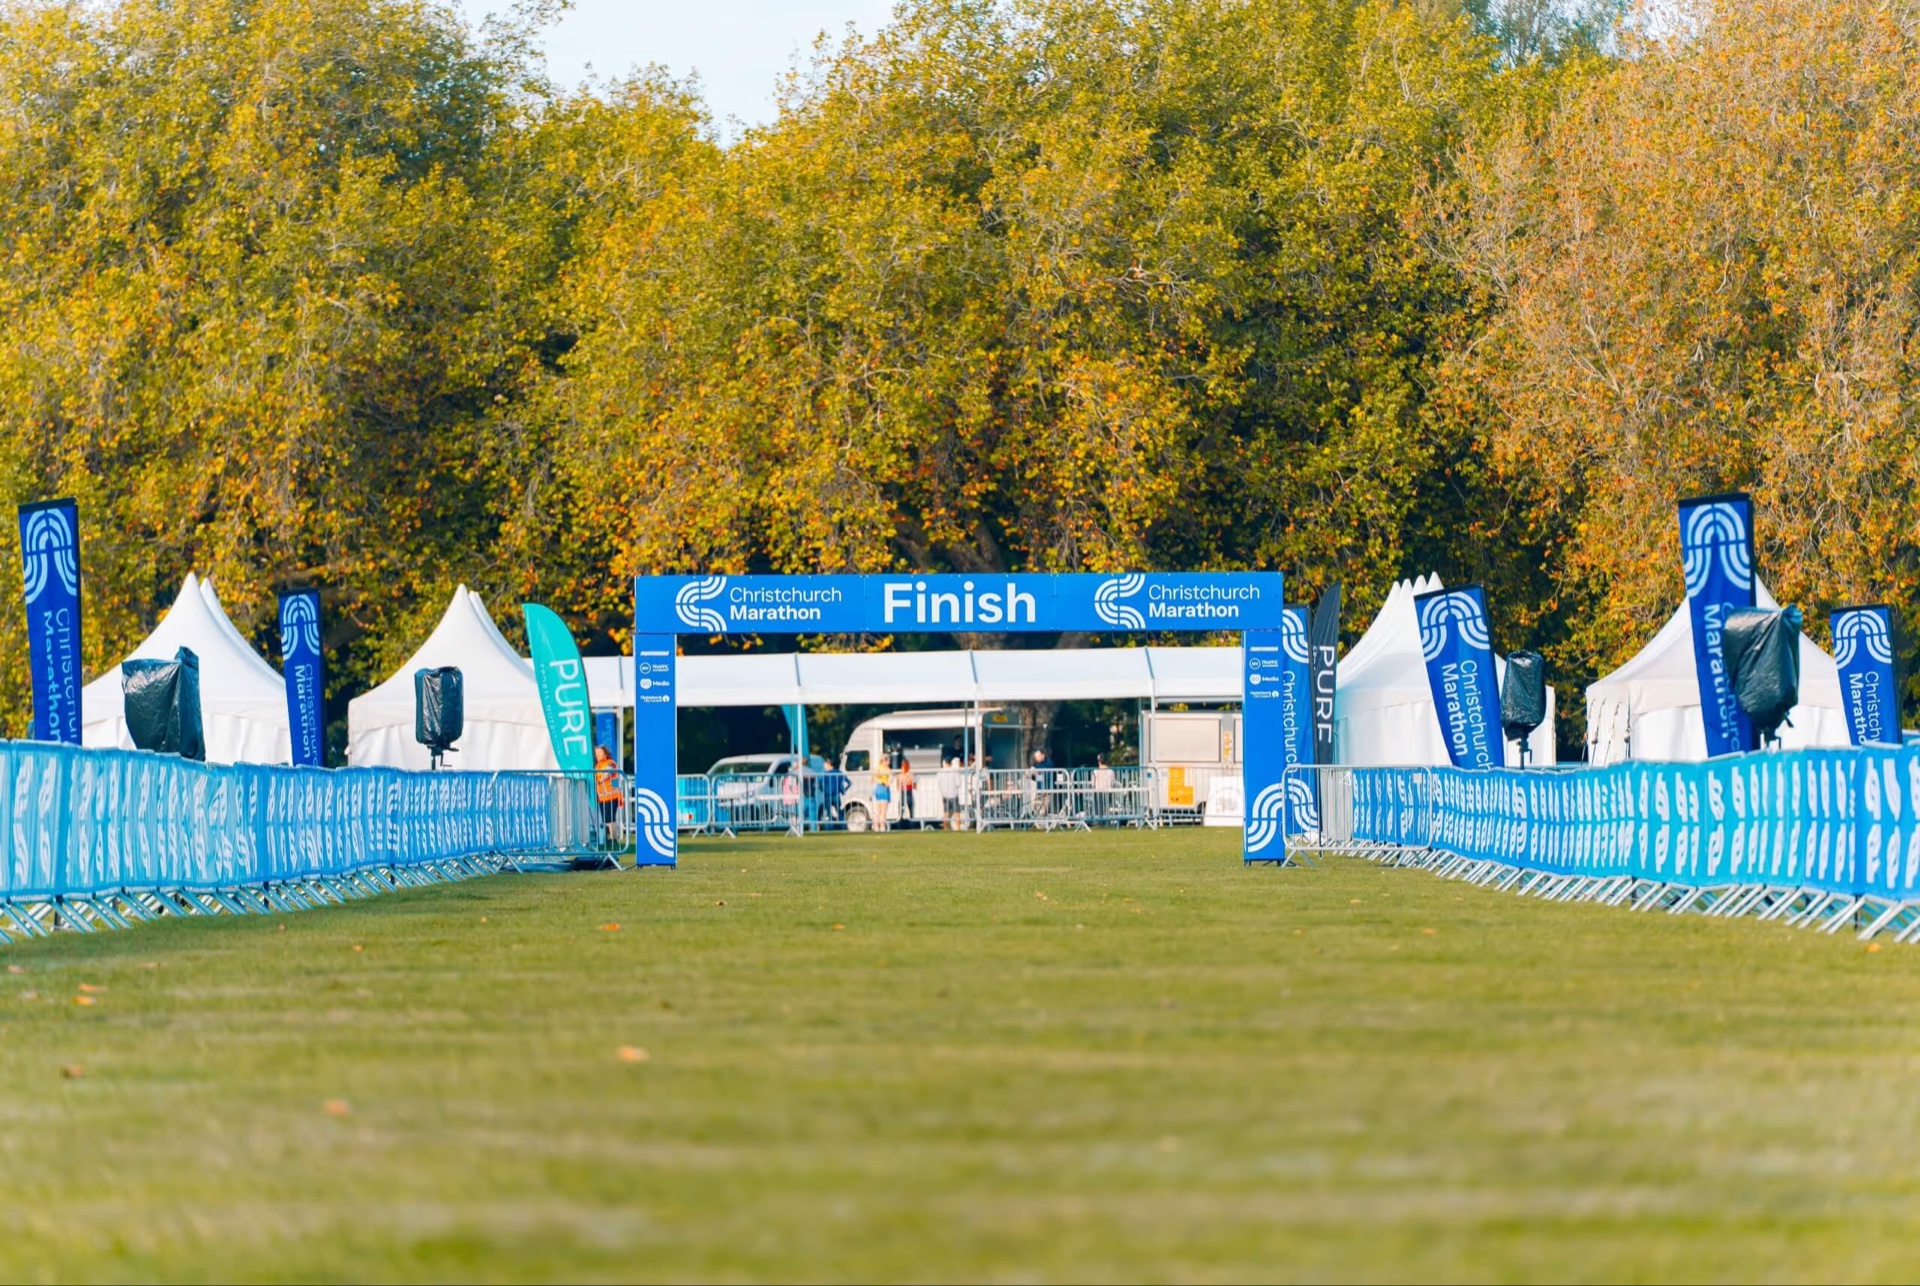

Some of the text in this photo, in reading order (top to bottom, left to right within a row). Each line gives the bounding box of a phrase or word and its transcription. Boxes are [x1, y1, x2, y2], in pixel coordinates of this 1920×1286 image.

[730, 586, 842, 603] Christchurch
[730, 604, 821, 620] Marathon
[884, 581, 1036, 623] Finish
[1148, 584, 1260, 600] Christchurch
[1148, 602, 1240, 617] Marathon
[294, 664, 311, 758] Marathon
[549, 658, 588, 756] PURE
[1316, 645, 1335, 743] PURE
[1442, 663, 1468, 756] Marathon
[1460, 659, 1494, 772] Christchurch
